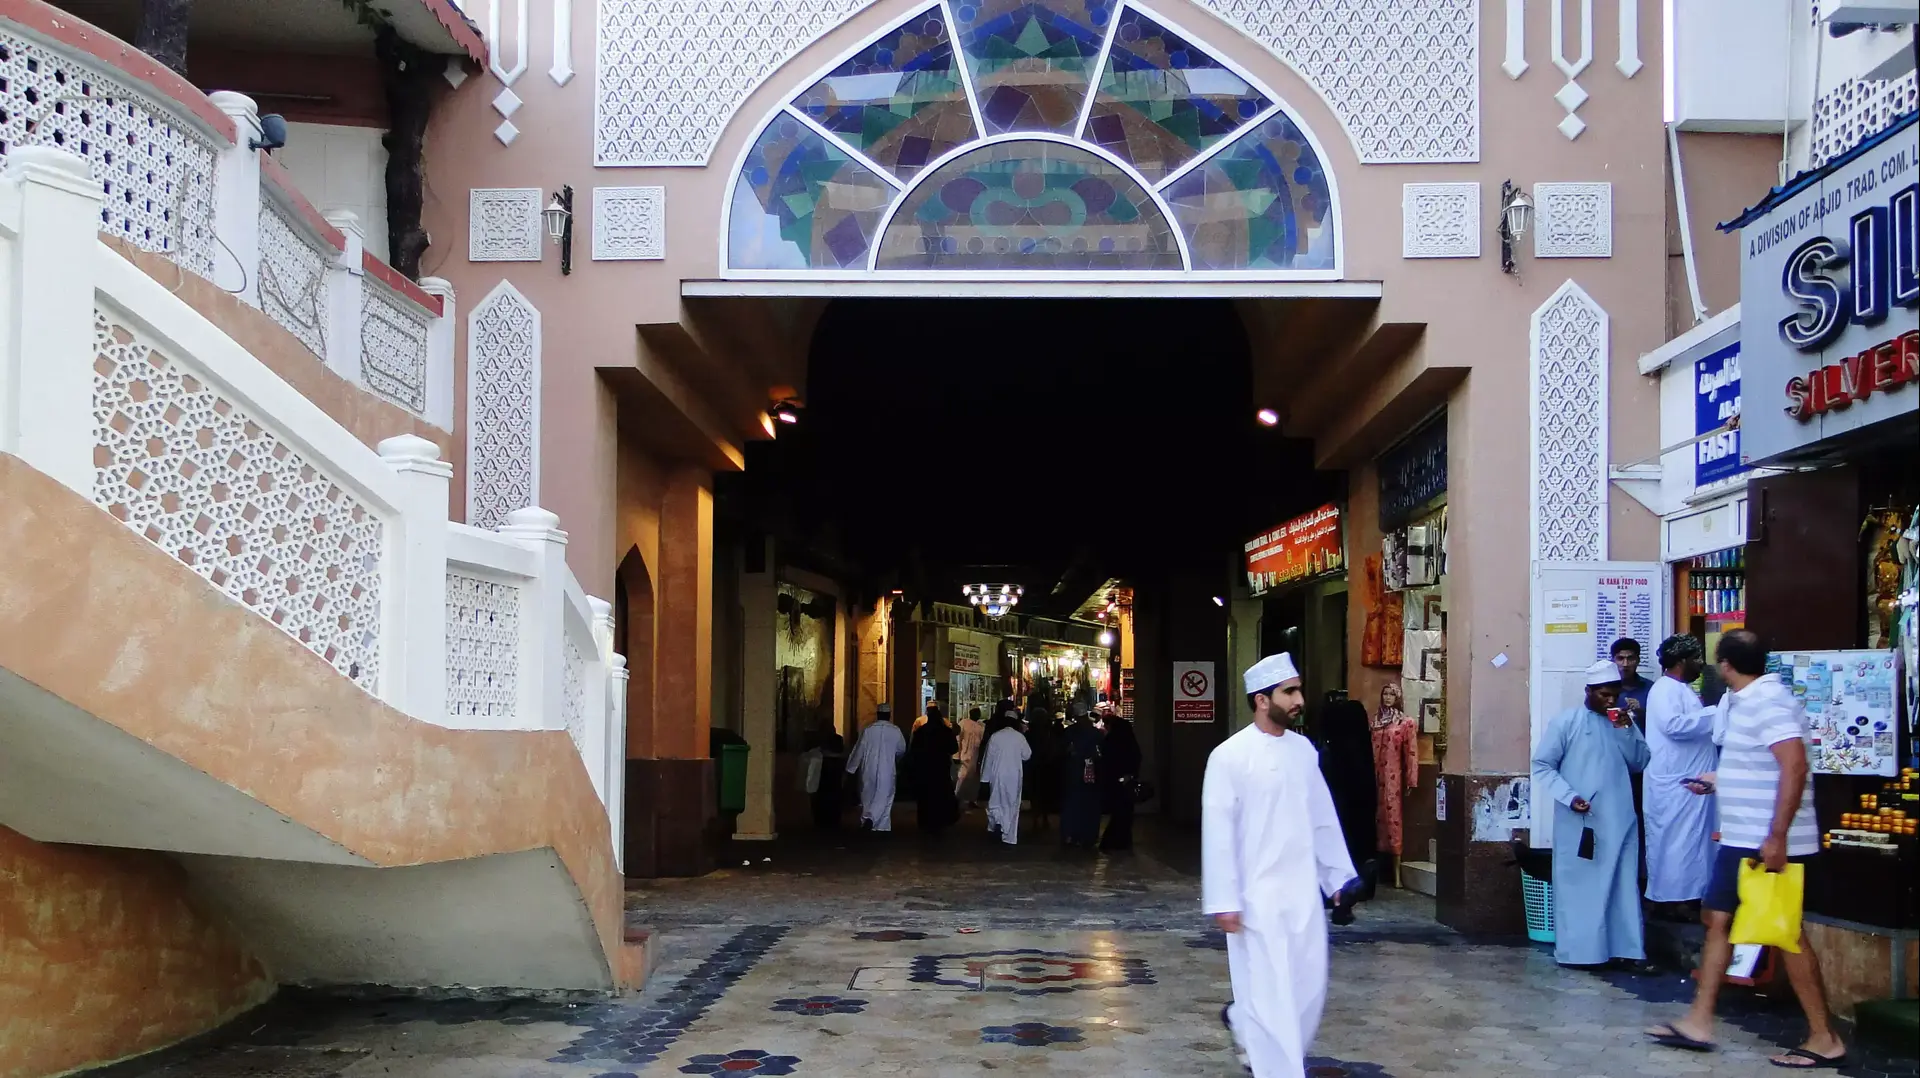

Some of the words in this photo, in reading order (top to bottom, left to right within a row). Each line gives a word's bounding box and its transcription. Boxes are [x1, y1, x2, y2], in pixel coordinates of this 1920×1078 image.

[1749, 239, 1756, 260] A
[1757, 214, 1796, 255] DIVISION
[1798, 205, 1811, 230] OF
[1812, 188, 1841, 223] ABJID
[1846, 168, 1878, 203] TRAD.
[1881, 150, 1908, 184] COM.
[1784, 329, 1919, 424] SILVER
[1699, 428, 1739, 465] FAST
[1622, 578, 1634, 586] FAST
[1635, 578, 1648, 586] FOOD
